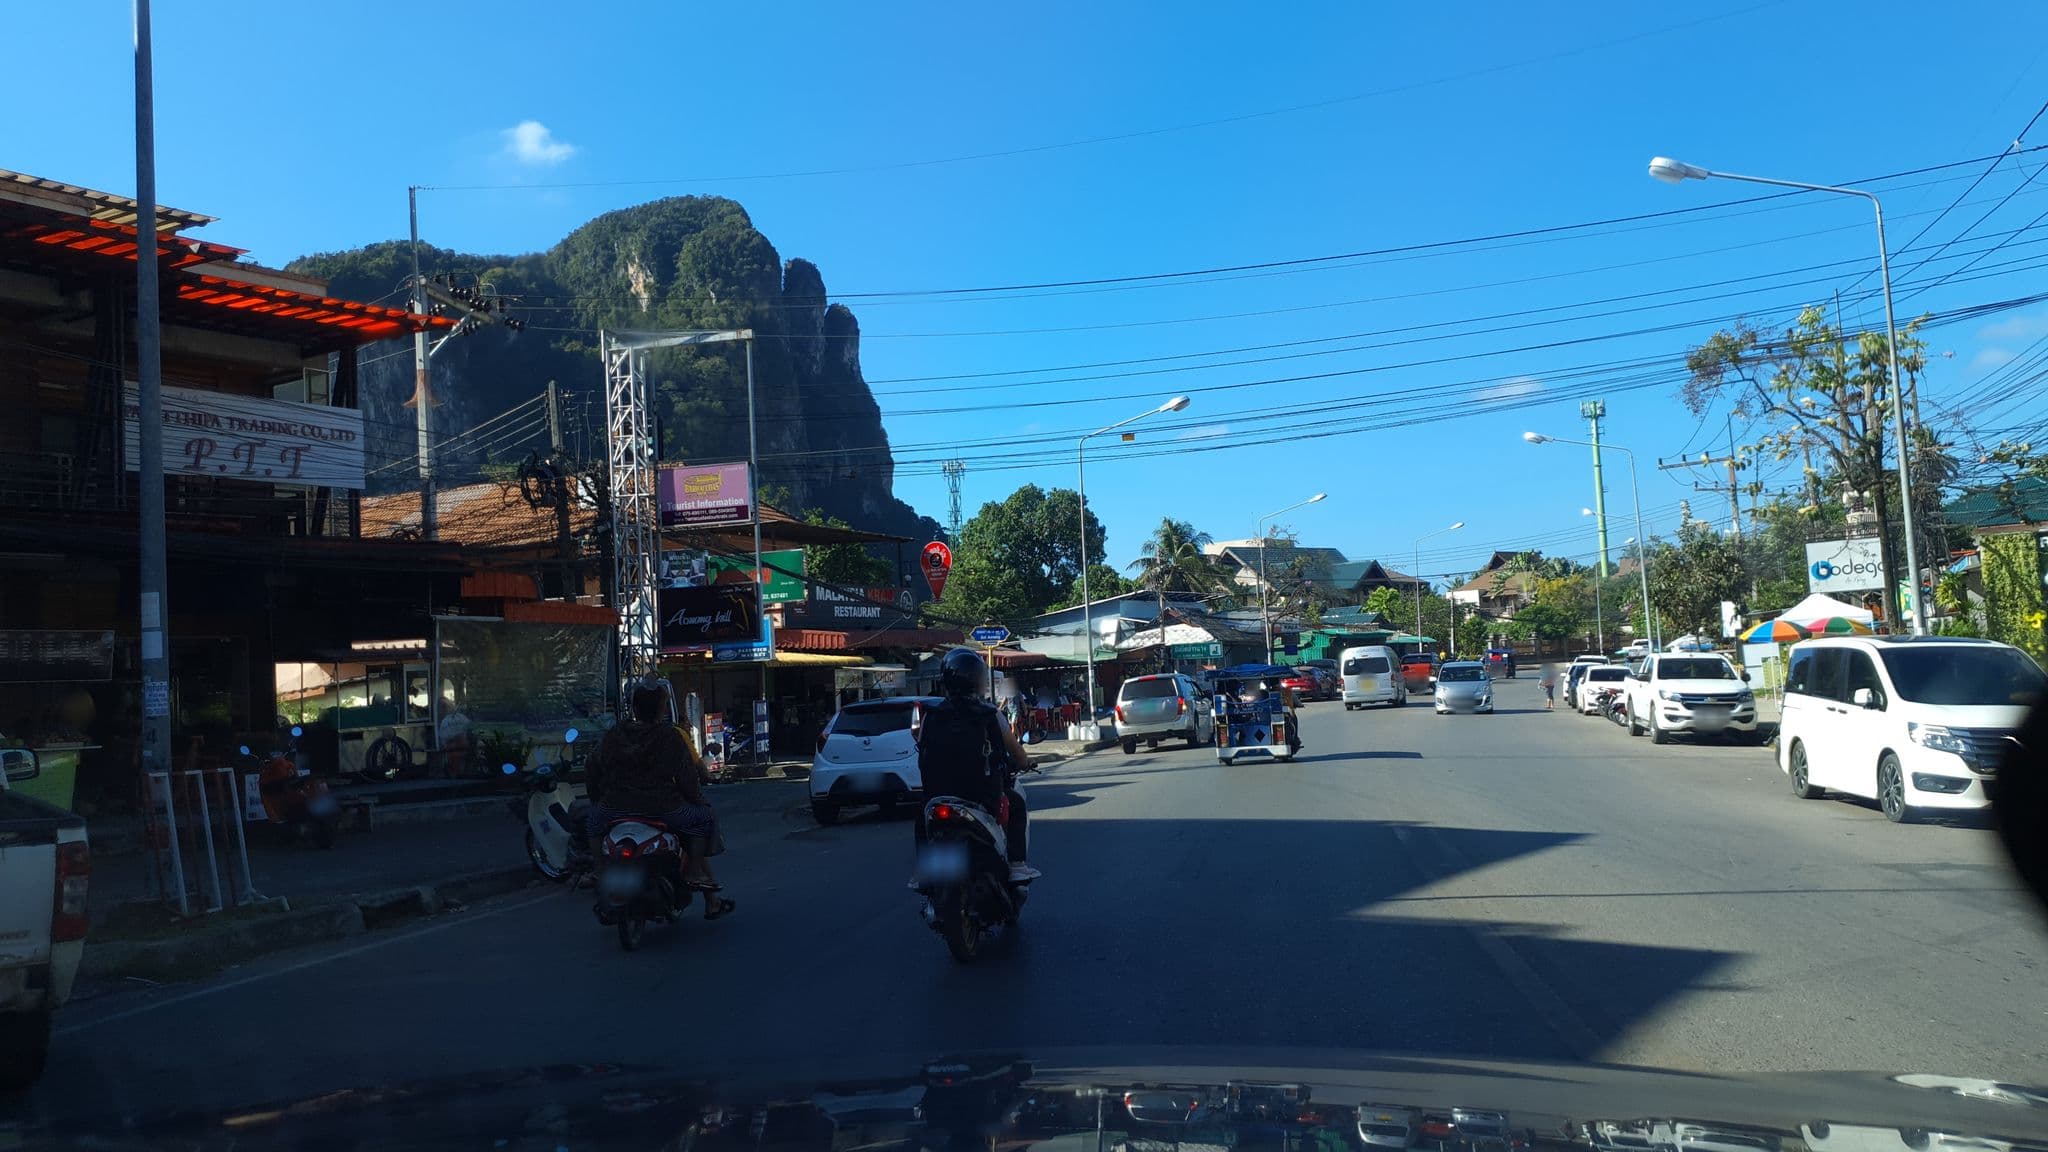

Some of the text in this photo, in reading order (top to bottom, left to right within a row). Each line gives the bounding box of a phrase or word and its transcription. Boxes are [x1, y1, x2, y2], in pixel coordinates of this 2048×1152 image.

[228, 416, 298, 436] TRADING
[667, 501, 695, 512] Tourist
[697, 497, 744, 509] Information
[834, 606, 881, 618] RESTAURANT
